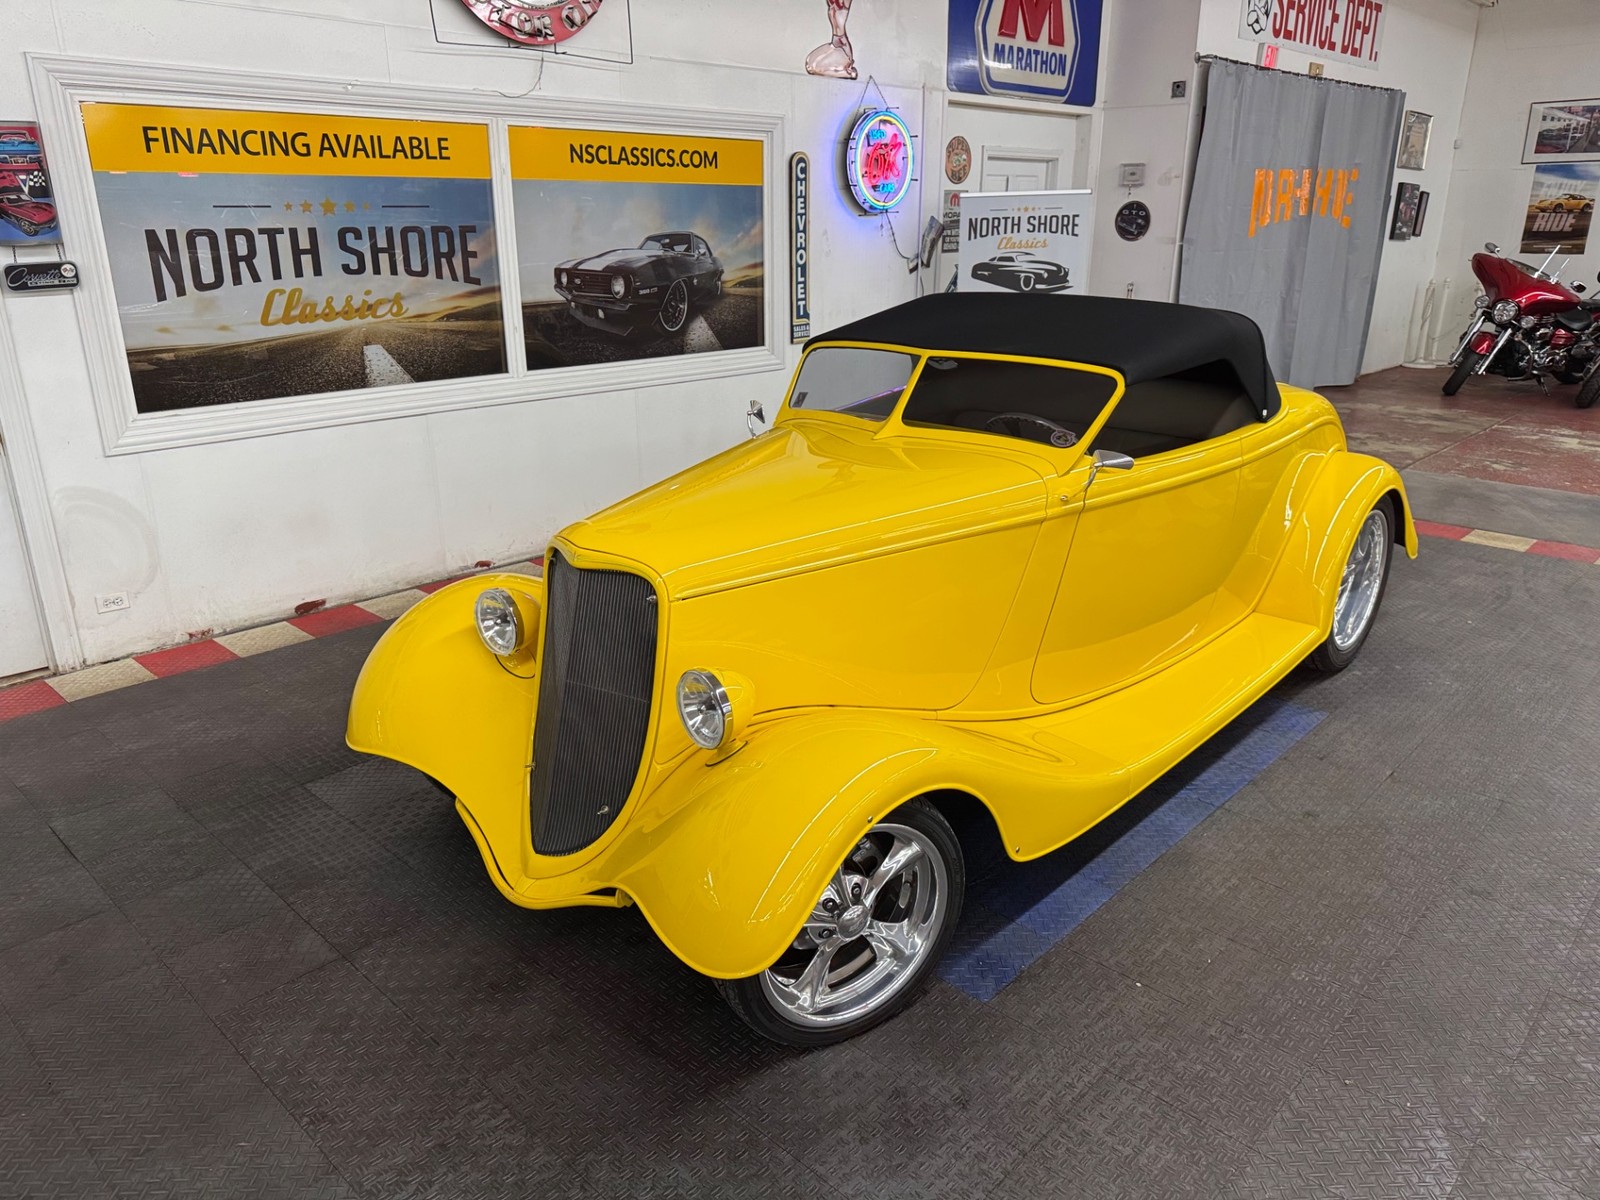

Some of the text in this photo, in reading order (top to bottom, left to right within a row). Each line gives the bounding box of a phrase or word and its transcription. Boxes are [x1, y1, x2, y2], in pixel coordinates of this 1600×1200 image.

[1272, 0, 1340, 52] SERVICE
[993, 43, 1067, 77] MARATHON
[141, 125, 451, 161] FINANCING AVAILABLE
[569, 143, 718, 169] NSCLASSICS.COM
[951, 164, 967, 181] BEE
[796, 162, 807, 316] CHEVROLET
[967, 215, 1021, 241] NORTH
[1026, 214, 1080, 237] SHORE
[1532, 212, 1576, 232] RIDE
[997, 236, 1049, 250] Classics
[144, 225, 482, 303] NORTH SHORE
[260, 287, 409, 327] Classics
